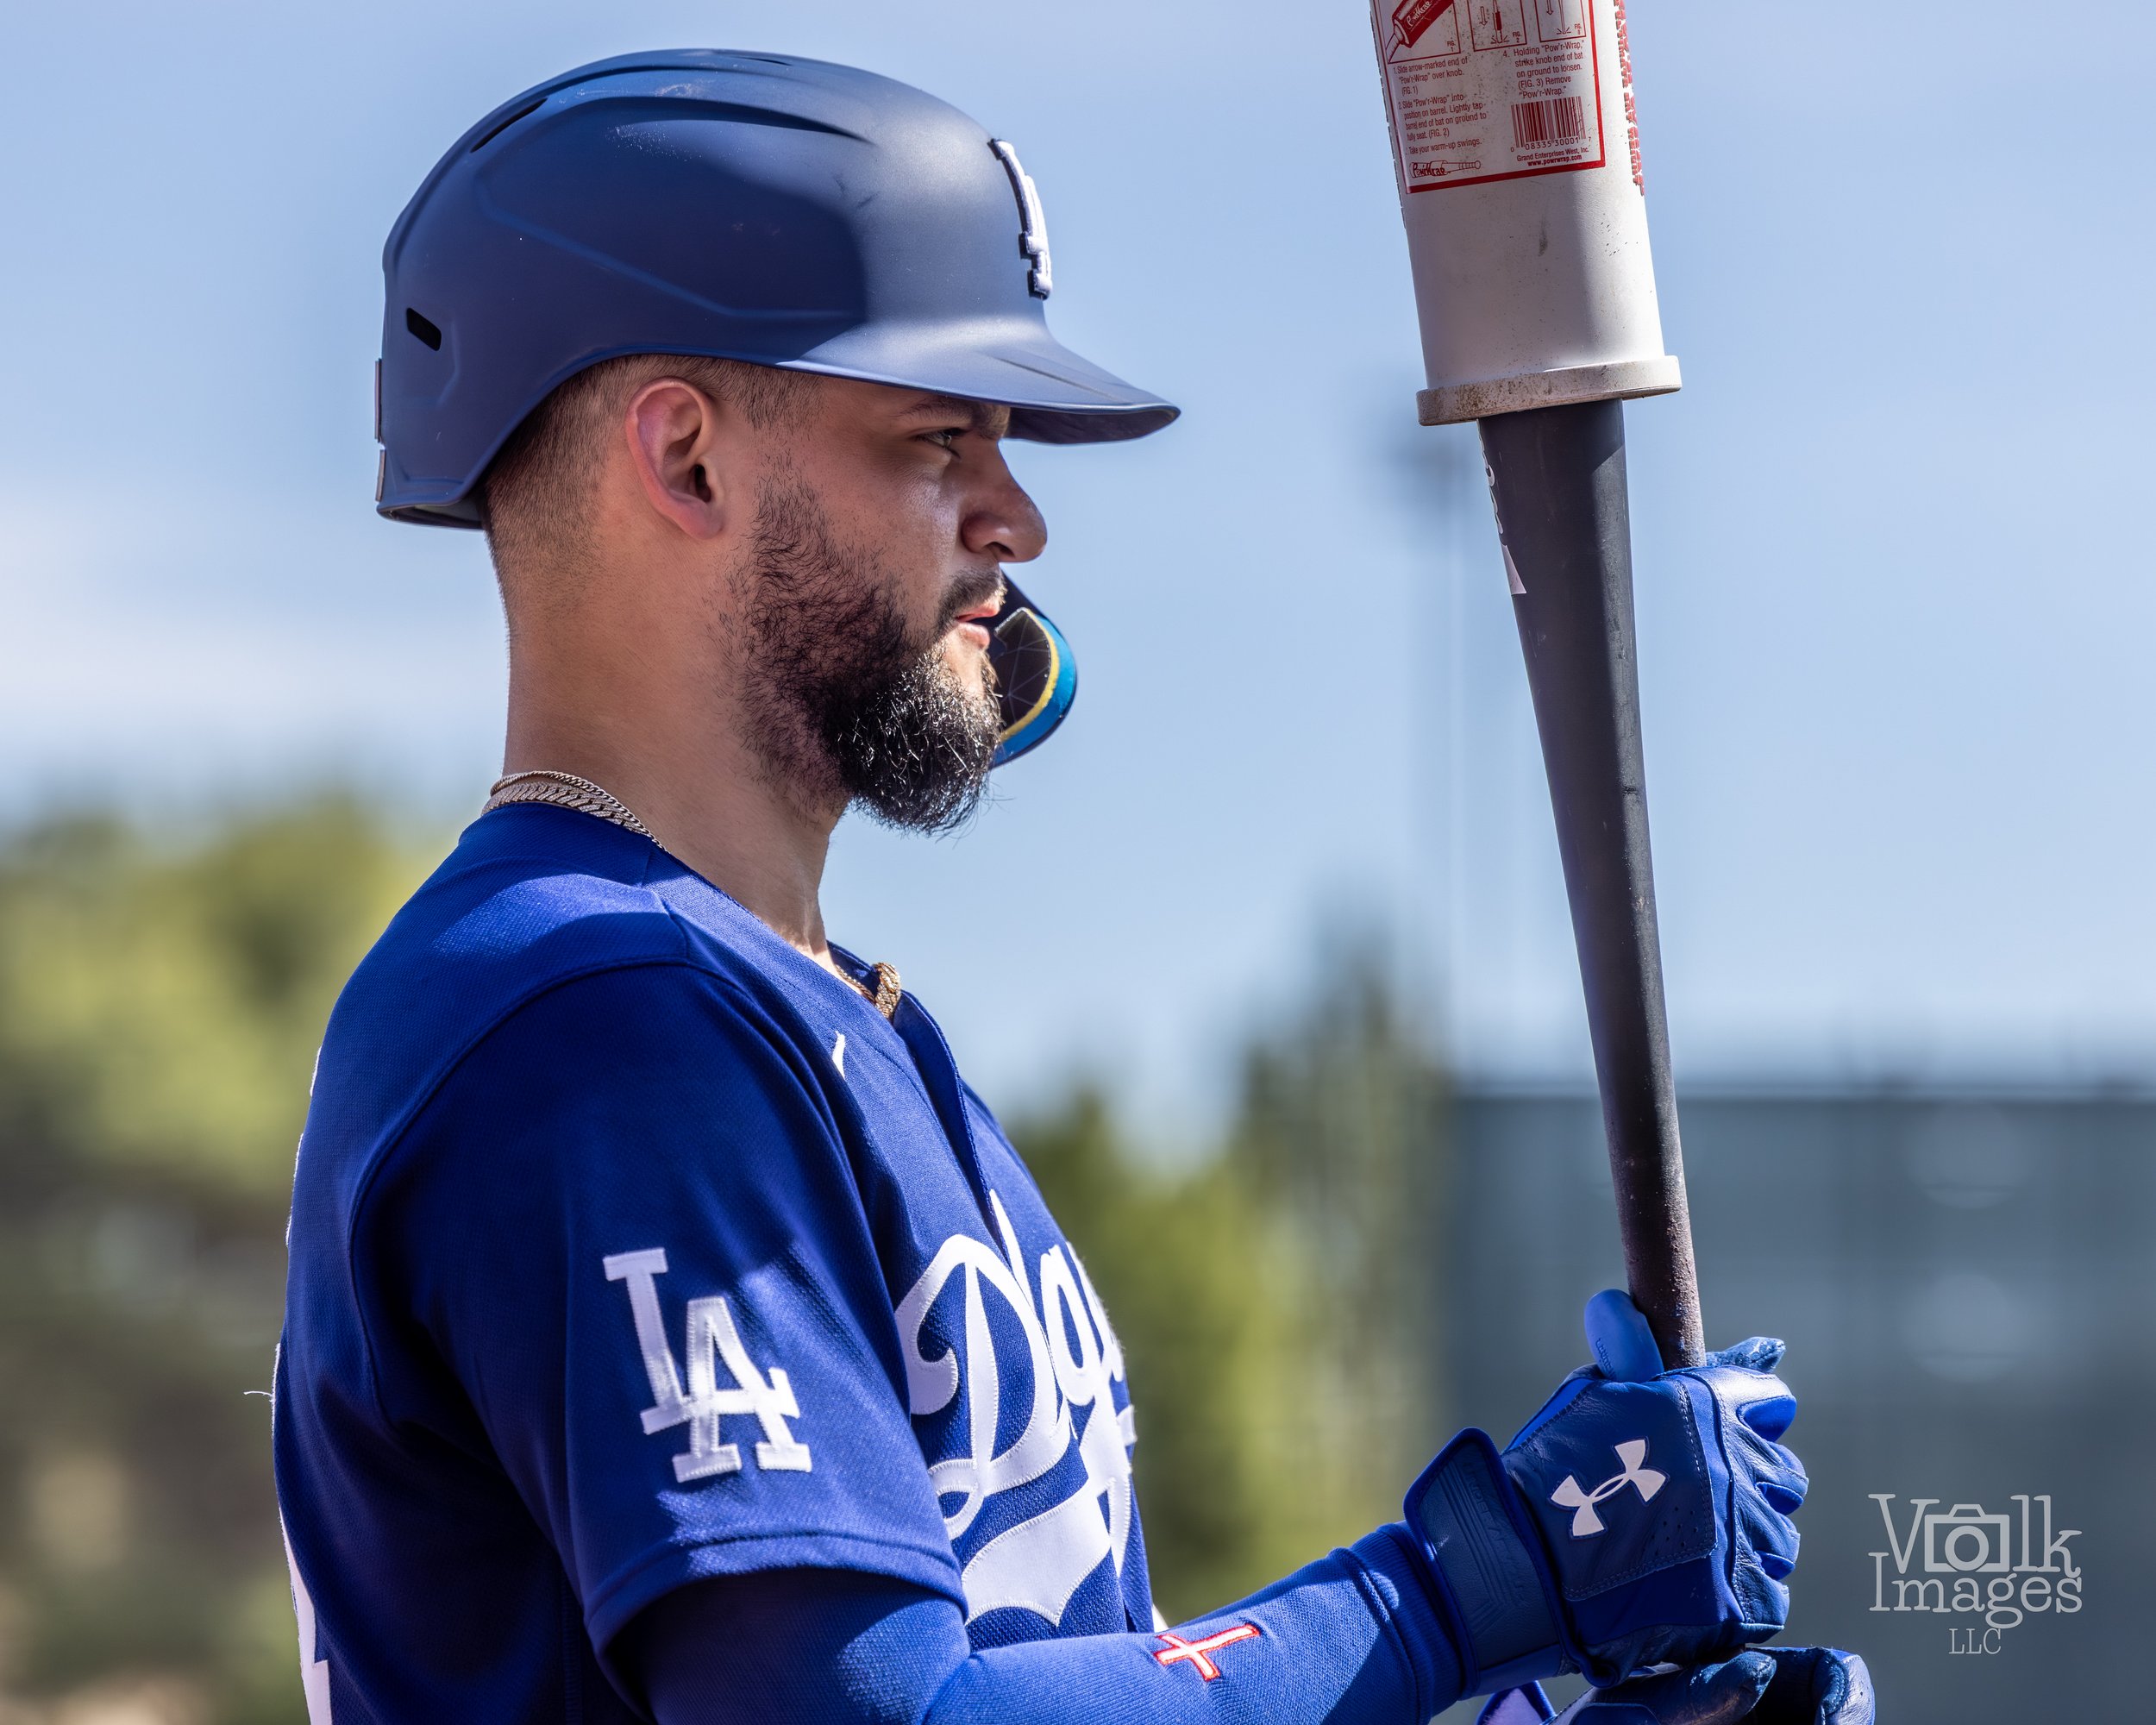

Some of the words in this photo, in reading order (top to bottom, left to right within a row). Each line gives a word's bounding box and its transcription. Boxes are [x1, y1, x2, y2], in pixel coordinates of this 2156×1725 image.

[1514, 47, 1539, 56] Holding
[1397, 66, 1407, 74] Slide
[1409, 60, 1446, 72] arrow-marked
[1447, 58, 1459, 66] end
[1514, 58, 1534, 67] strike
[1535, 55, 1551, 65] knob
[1553, 53, 1565, 63] end
[1446, 69, 1464, 78] knob.
[1527, 66, 1551, 78] ground
[1560, 63, 1583, 72] loosen.
[1518, 80, 1535, 91] (FIG.
[1537, 78, 1544, 87] 3)
[1545, 76, 1571, 85] Remove
[1402, 100, 1413, 110] Slide
[1451, 93, 1464, 102] into
[1404, 111, 1421, 121] position
[1430, 106, 1448, 116] barrel.
[1450, 103, 1471, 113] Lightly
[1472, 102, 1483, 111] tap
[1406, 122, 1418, 130] barrel
[1418, 120, 1427, 129] end
[1428, 118, 1434, 127] of
[1435, 116, 1445, 126] bat
[1455, 112, 1478, 125] ground
[1428, 129, 1441, 139] (FIG.
[1443, 128, 1450, 137] 2)
[1419, 144, 1430, 155] your
[1431, 141, 1456, 152] warm-up
[1457, 138, 1482, 148] swings.
[1525, 140, 1551, 150] 08335
[1555, 137, 1579, 147] 30001
[1527, 154, 1583, 166] www.powrwrap.com
[1535, 149, 1564, 160] Enterprises
[603, 1247, 812, 1484] LA
